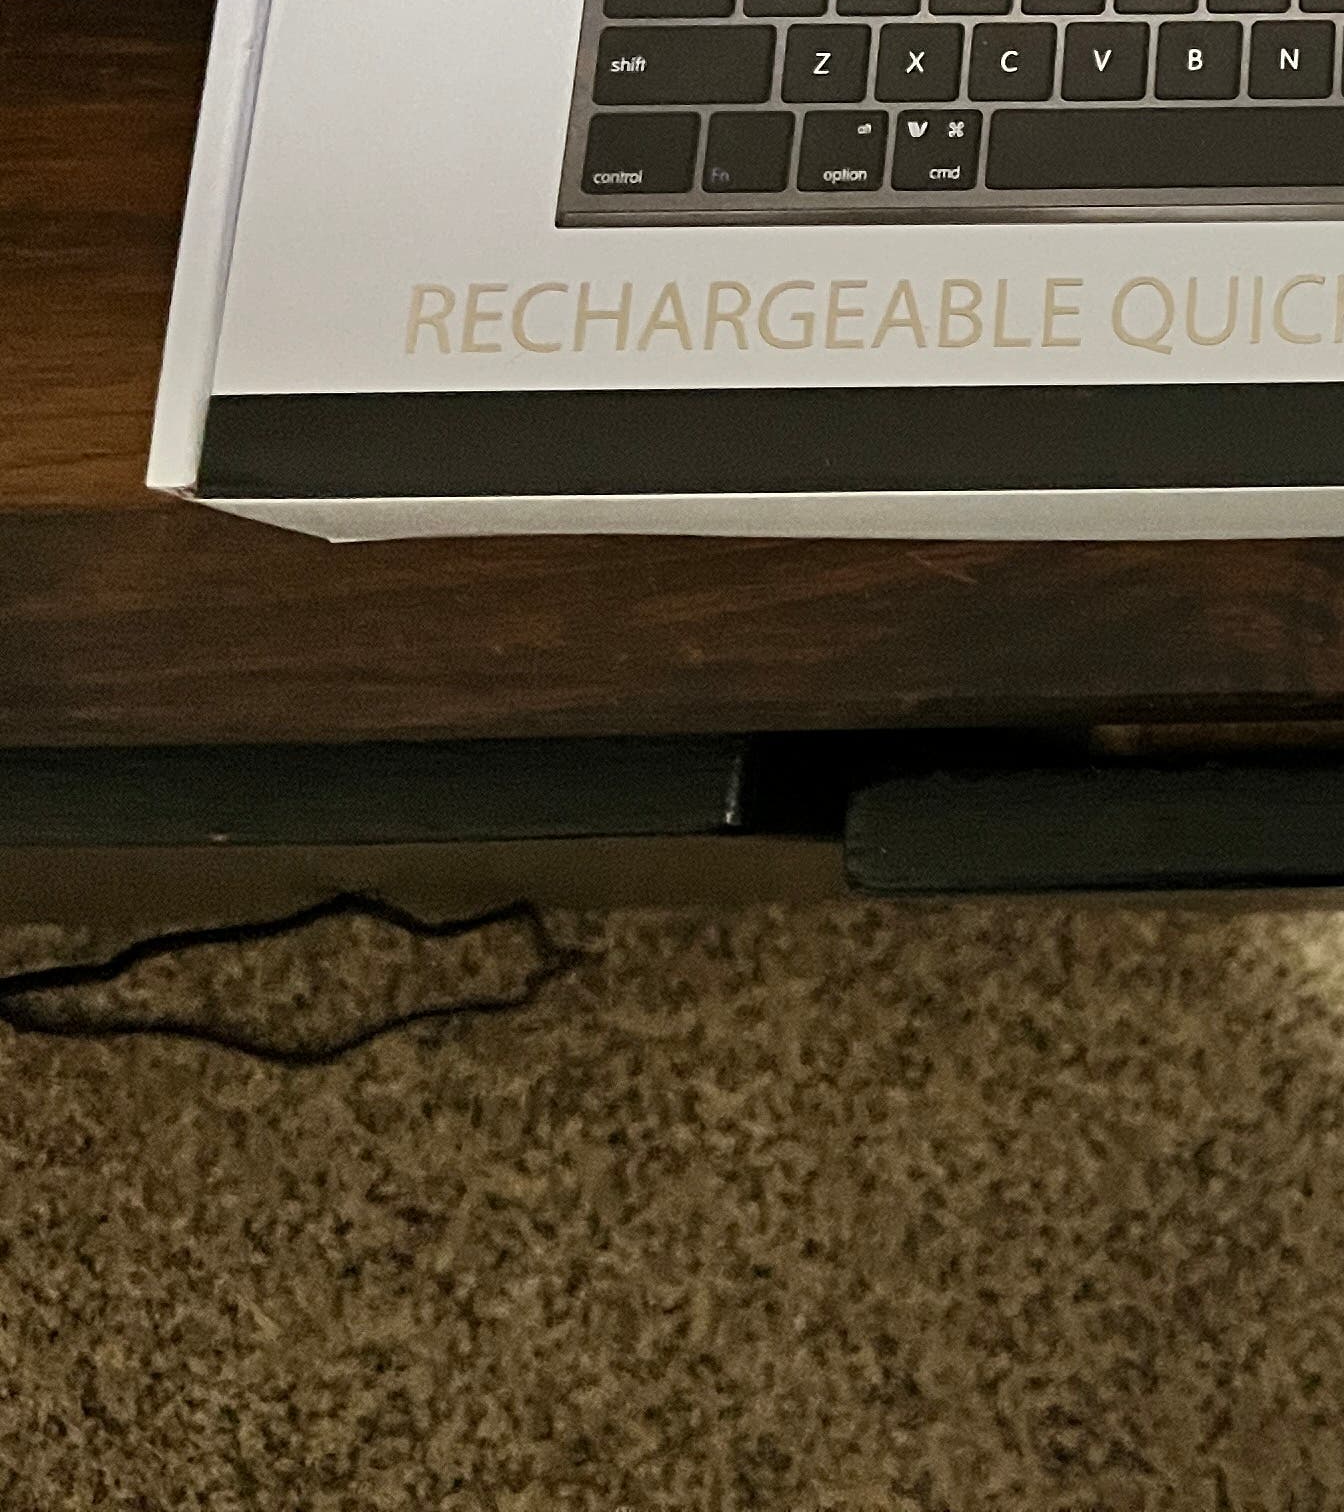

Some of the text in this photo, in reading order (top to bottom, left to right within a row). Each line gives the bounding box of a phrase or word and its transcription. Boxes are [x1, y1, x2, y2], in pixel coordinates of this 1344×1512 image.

[610, 56, 646, 73] shift
[812, 52, 832, 75] Z
[905, 50, 925, 74] X
[1000, 50, 1019, 73] C
[1093, 49, 1112, 72] V
[1187, 48, 1203, 71] B
[1280, 47, 1300, 70] N
[593, 169, 643, 185] control
[823, 168, 868, 185] option
[929, 165, 961, 180] cmd
[406, 279, 1084, 354] RECHARGEABLE
